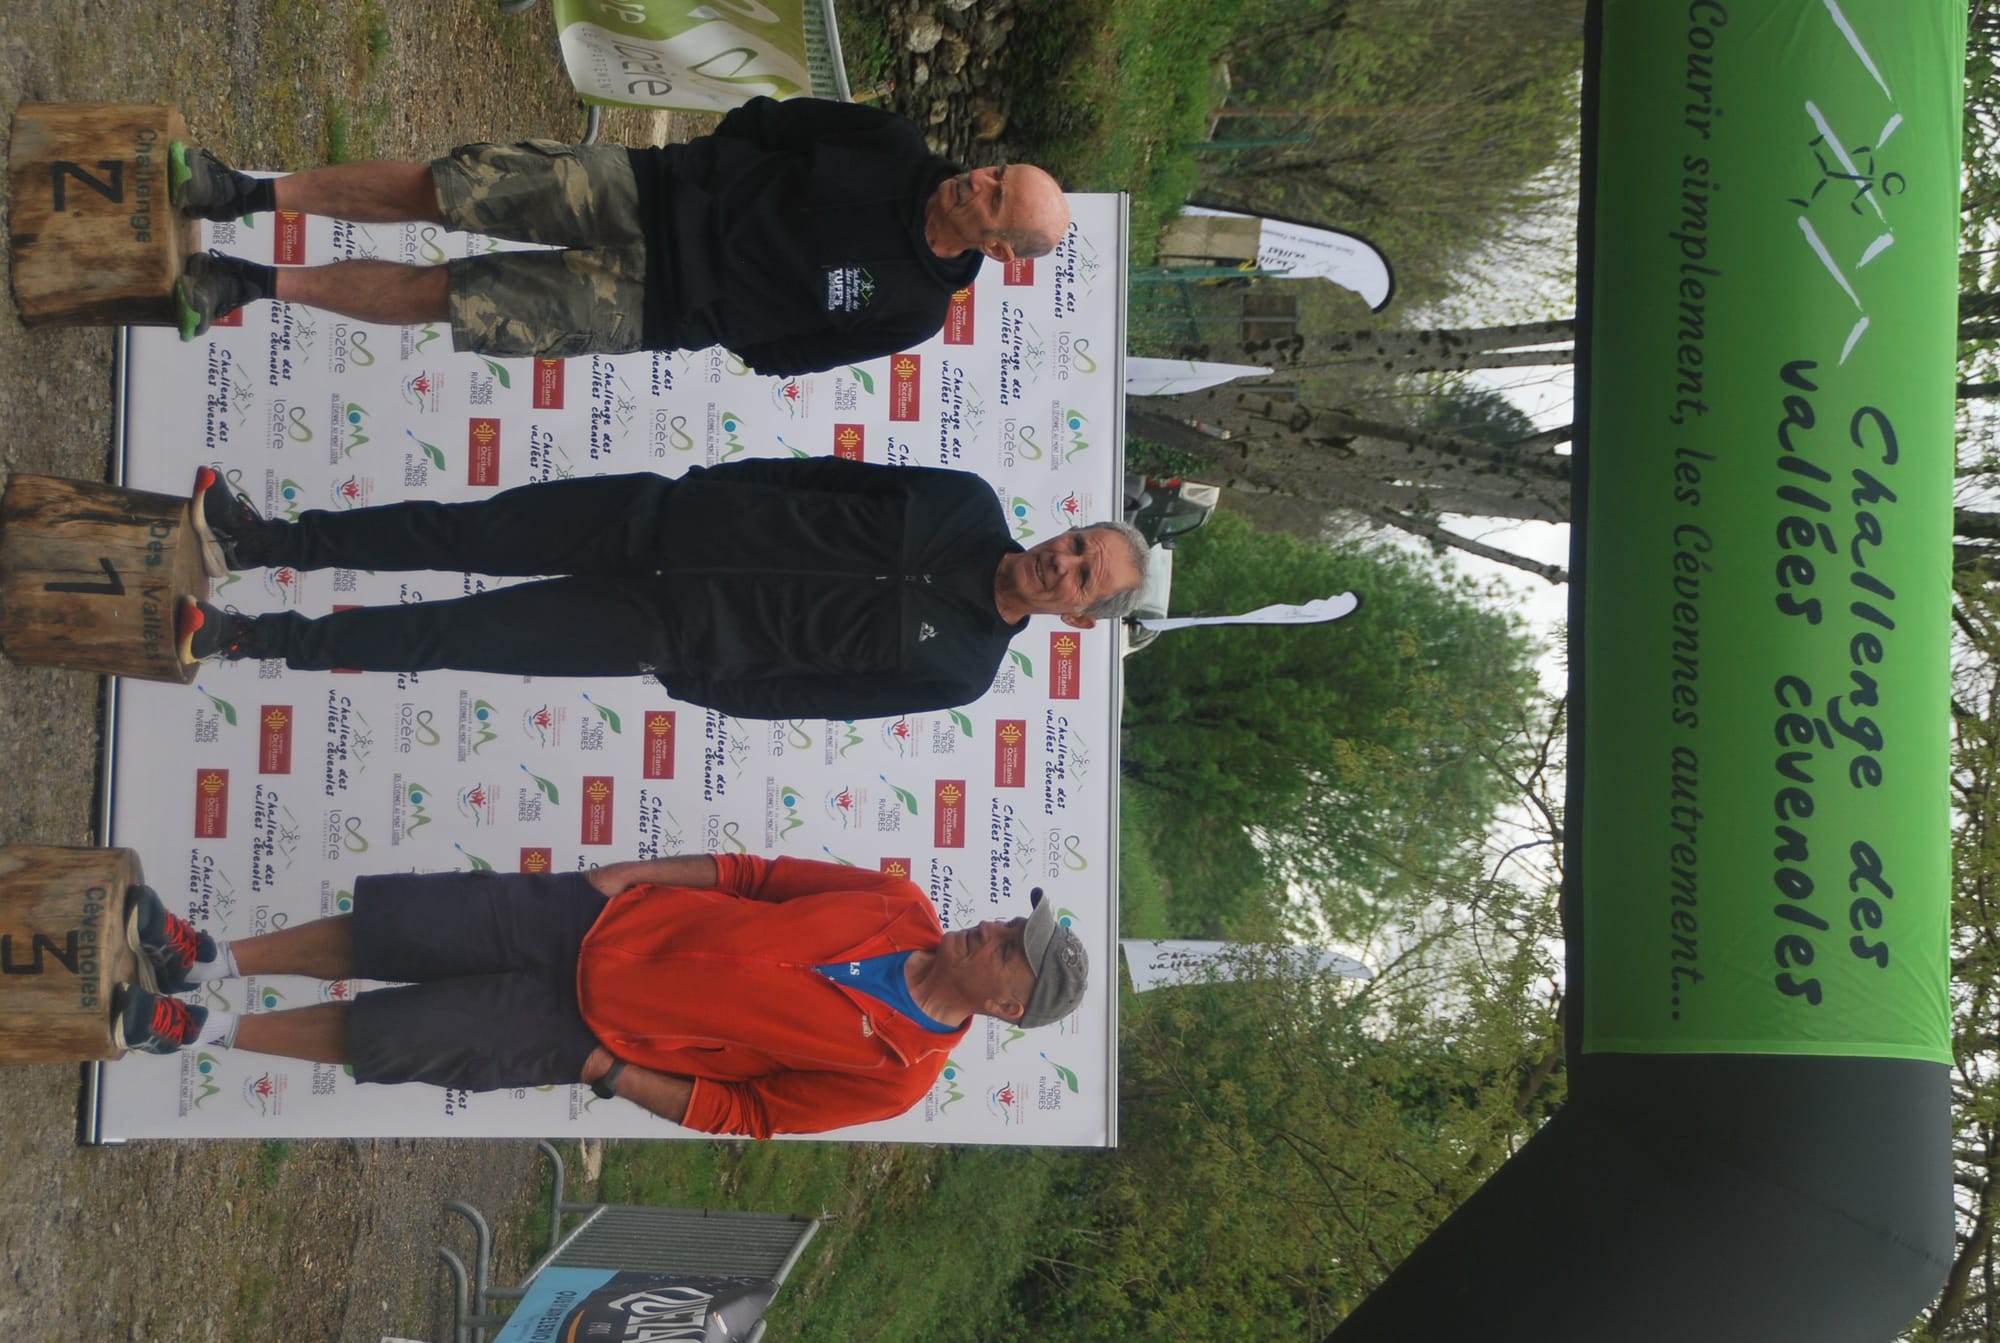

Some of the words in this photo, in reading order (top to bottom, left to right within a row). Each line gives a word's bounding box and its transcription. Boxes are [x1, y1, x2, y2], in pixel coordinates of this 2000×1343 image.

[1680, 1, 1729, 140] Courir
[130, 127, 159, 244] Challenge
[1064, 221, 1078, 284] Challenge
[1054, 266, 1065, 319] cévenoles
[1067, 293, 1076, 313] des
[1667, 155, 1723, 427] simplement,
[1001, 301, 1011, 344] vallées
[1010, 308, 1024, 371] Challenge
[207, 342, 218, 387] vallées
[269, 332, 281, 386] cévenoles
[282, 359, 292, 380] des
[334, 323, 348, 374] lozère
[1057, 331, 1071, 381] lozère
[219, 349, 232, 415] Challenge
[485, 377, 493, 405] FLORAC
[592, 355, 600, 399] vallées
[600, 362, 614, 426] Challenge
[664, 369, 673, 390] des
[842, 389, 850, 411] TROIS
[941, 360, 952, 404] vallées
[950, 368, 963, 431] Challenge
[1000, 352, 1011, 406] cévenoles
[1013, 379, 1023, 399] des
[206, 394, 218, 449] cévenoles
[220, 422, 230, 442] des
[272, 400, 287, 449] lozère
[530, 425, 540, 468] vallées
[590, 406, 600, 460] cévenoles
[603, 433, 612, 454] des
[655, 409, 668, 458] lozère
[940, 411, 951, 465] cévenoles
[1003, 418, 1017, 468] lozère
[420, 459, 428, 487] FLORAC
[952, 439, 962, 458] des
[412, 465, 420, 487] TROIS
[1672, 447, 1716, 504] les
[1775, 359, 1837, 625] vallées
[43, 557, 126, 597] 1
[1827, 405, 1899, 789] Challenge
[141, 584, 164, 663] Vallées
[1670, 523, 1714, 728] Cévennes
[1000, 672, 1008, 694] TROIS
[1008, 666, 1016, 694] FLORAC
[203, 721, 211, 743] TROIS
[211, 714, 219, 743] FLORAC
[327, 689, 338, 733] vallées
[338, 697, 351, 761] Challenge
[400, 703, 413, 753] lozère
[1045, 709, 1055, 753] vallées
[588, 729, 596, 750] TROIS
[714, 714, 728, 767] hallenge
[940, 731, 948, 754] TROIS
[1054, 716, 1068, 781] Challenge
[325, 742, 338, 796] cévenoles
[338, 768, 349, 790] des
[704, 747, 714, 802] cévenoles
[717, 774, 727, 795] des
[1044, 761, 1055, 815] cévenoles
[254, 784, 265, 829] vallées
[264, 791, 278, 856] Challenge
[526, 800, 534, 822] TROIS
[639, 789, 648, 833] vallées
[991, 798, 1003, 841] vallées
[1057, 788, 1067, 809] des
[328, 809, 342, 861] lozère
[651, 797, 662, 861] Challenge
[1000, 805, 1014, 869] Challenge
[1048, 828, 1063, 878] lozère
[1774, 675, 1835, 1006] cévenoles
[189, 849, 201, 893] vallées
[201, 856, 213, 921] Challenge
[252, 837, 265, 892] cévenoles
[265, 864, 276, 885] des
[930, 858, 940, 902] vallées
[990, 849, 1001, 904] cévenoles
[1002, 876, 1012, 898] des
[1670, 746, 1704, 1022] autrement...
[940, 865, 952, 929] Challenge
[1849, 841, 1893, 968] des
[1, 930, 79, 975] 3
[80, 886, 107, 1007] Cévenoles
[320, 1072, 328, 1095] TROIS
[1046, 1088, 1054, 1110] TROIS
